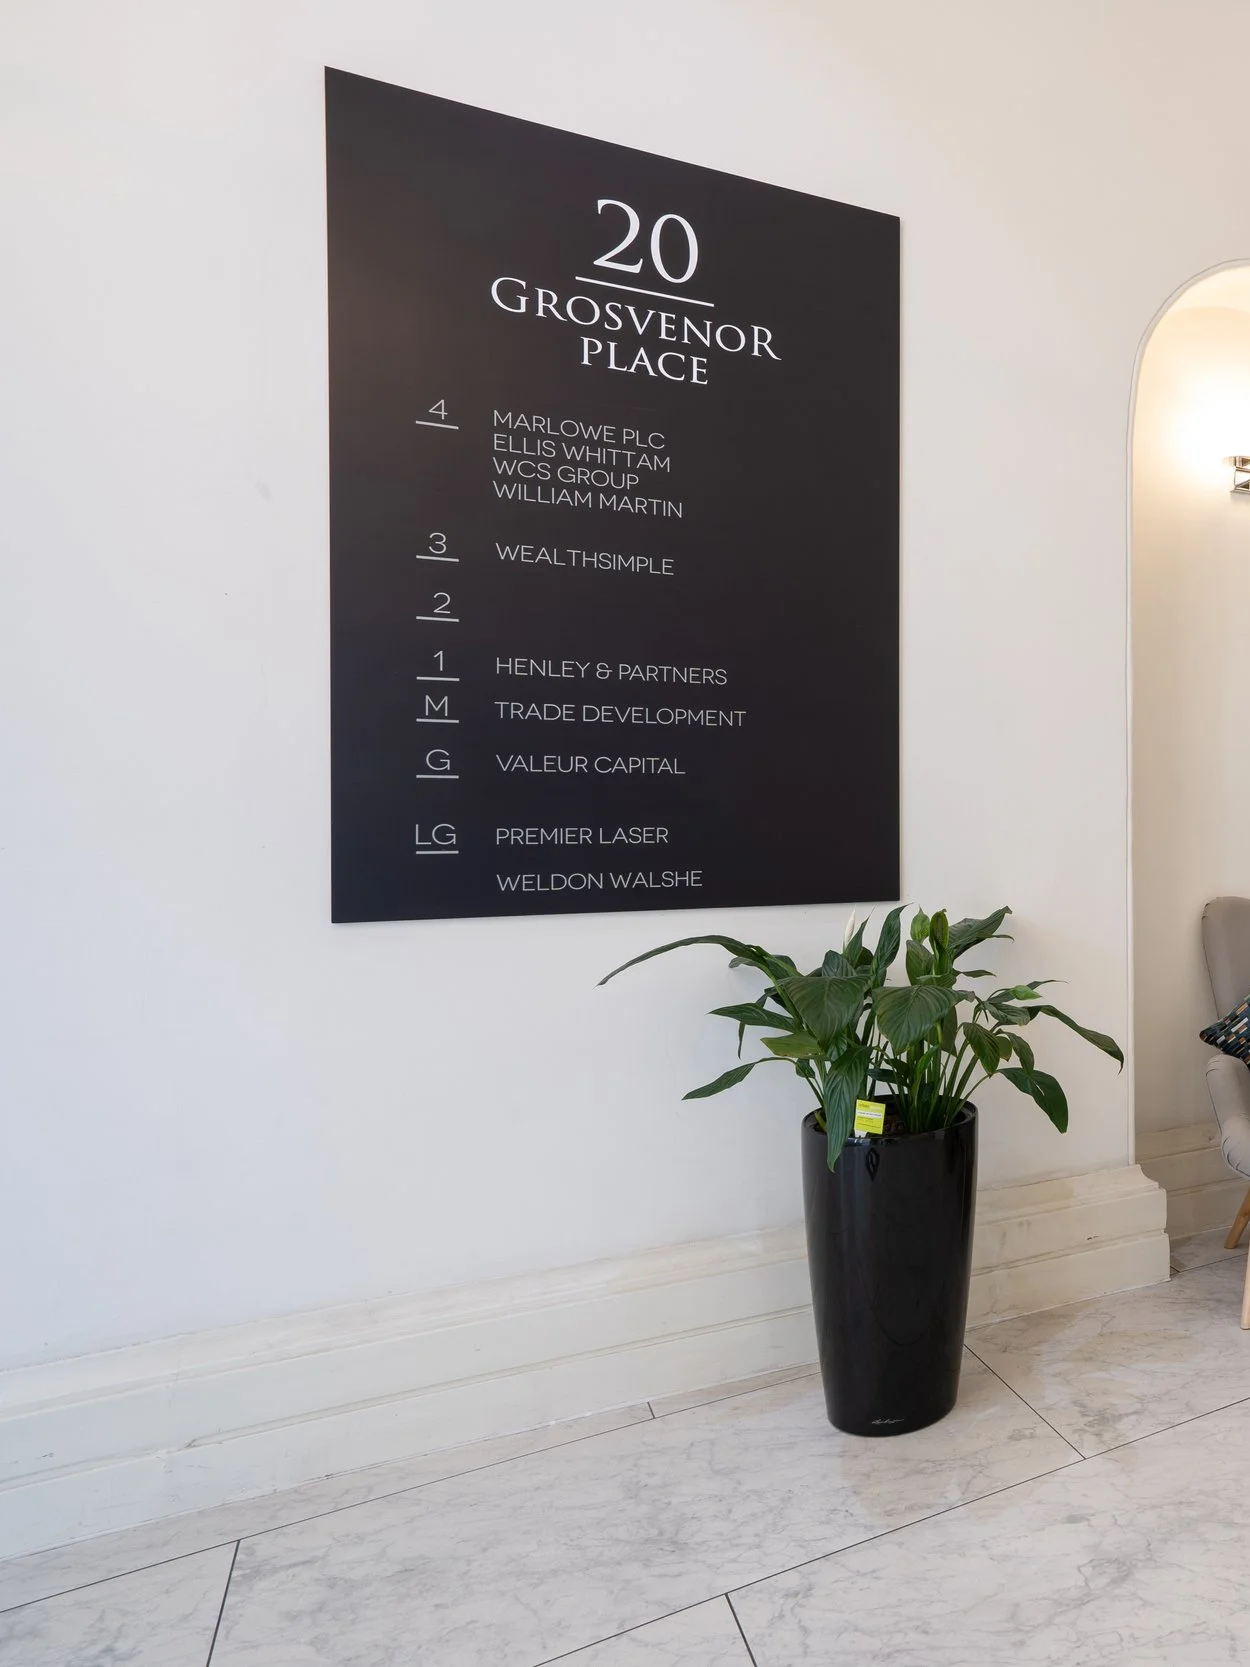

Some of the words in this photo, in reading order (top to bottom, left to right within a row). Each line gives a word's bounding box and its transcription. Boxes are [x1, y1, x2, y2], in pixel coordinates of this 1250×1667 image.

[592, 198, 699, 284] 20
[490, 276, 783, 361] GROSVENOR
[579, 335, 709, 385] PLACE
[427, 398, 449, 421] 4
[493, 409, 617, 444] MARLOWE
[622, 427, 665, 450] PLC
[493, 432, 556, 458] ELLIS
[561, 442, 671, 473] WHITTAM
[492, 456, 551, 481] WCS
[556, 465, 640, 491] GROUP
[492, 479, 592, 509] WILLIAM
[599, 492, 683, 519] MARTIN
[428, 532, 447, 555] 3
[495, 542, 675, 576] WEALTHSIMPLE
[432, 591, 451, 614] 2
[433, 650, 444, 672] 1
[496, 656, 591, 679] HENLEY
[595, 662, 613, 680] &
[618, 663, 728, 686] PARTNERS
[425, 694, 449, 717] M
[493, 701, 576, 722] TRADE
[582, 704, 747, 727] DEVELOPMENT
[425, 748, 451, 771] G
[495, 754, 589, 773] VALEUR
[594, 756, 686, 775] CAPITAL
[415, 823, 457, 846] LG
[496, 827, 593, 845] PREMIER
[599, 826, 669, 844] LASER
[496, 872, 603, 892] WELDON
[609, 870, 703, 889] WALSHE
